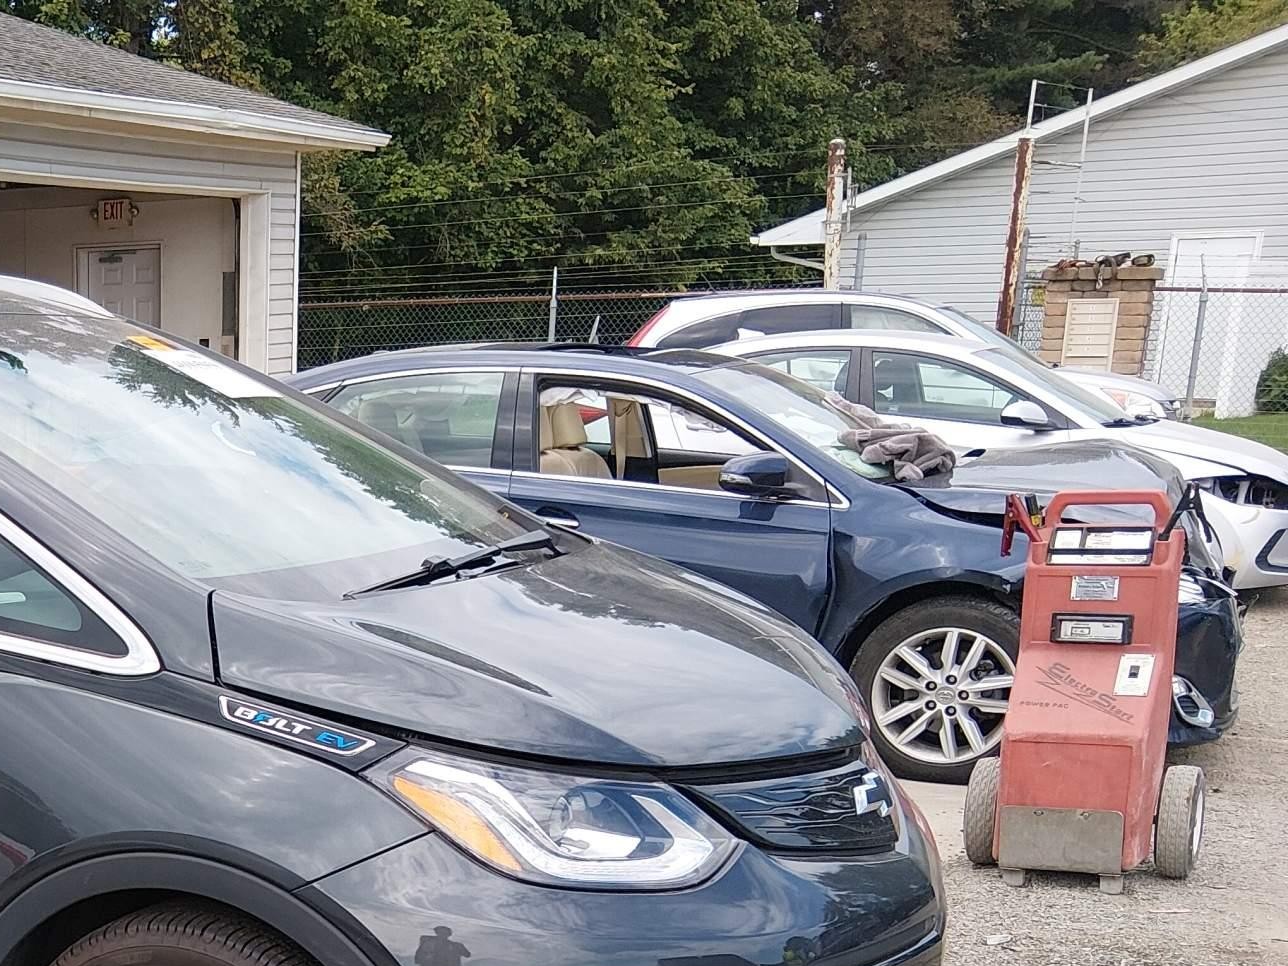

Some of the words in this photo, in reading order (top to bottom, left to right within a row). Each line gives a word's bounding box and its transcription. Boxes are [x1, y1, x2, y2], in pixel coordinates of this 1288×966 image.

[103, 201, 124, 220] EXIT
[1092, 692, 1134, 721] Start
[233, 706, 312, 735] BOLT
[315, 731, 358, 749] EV
